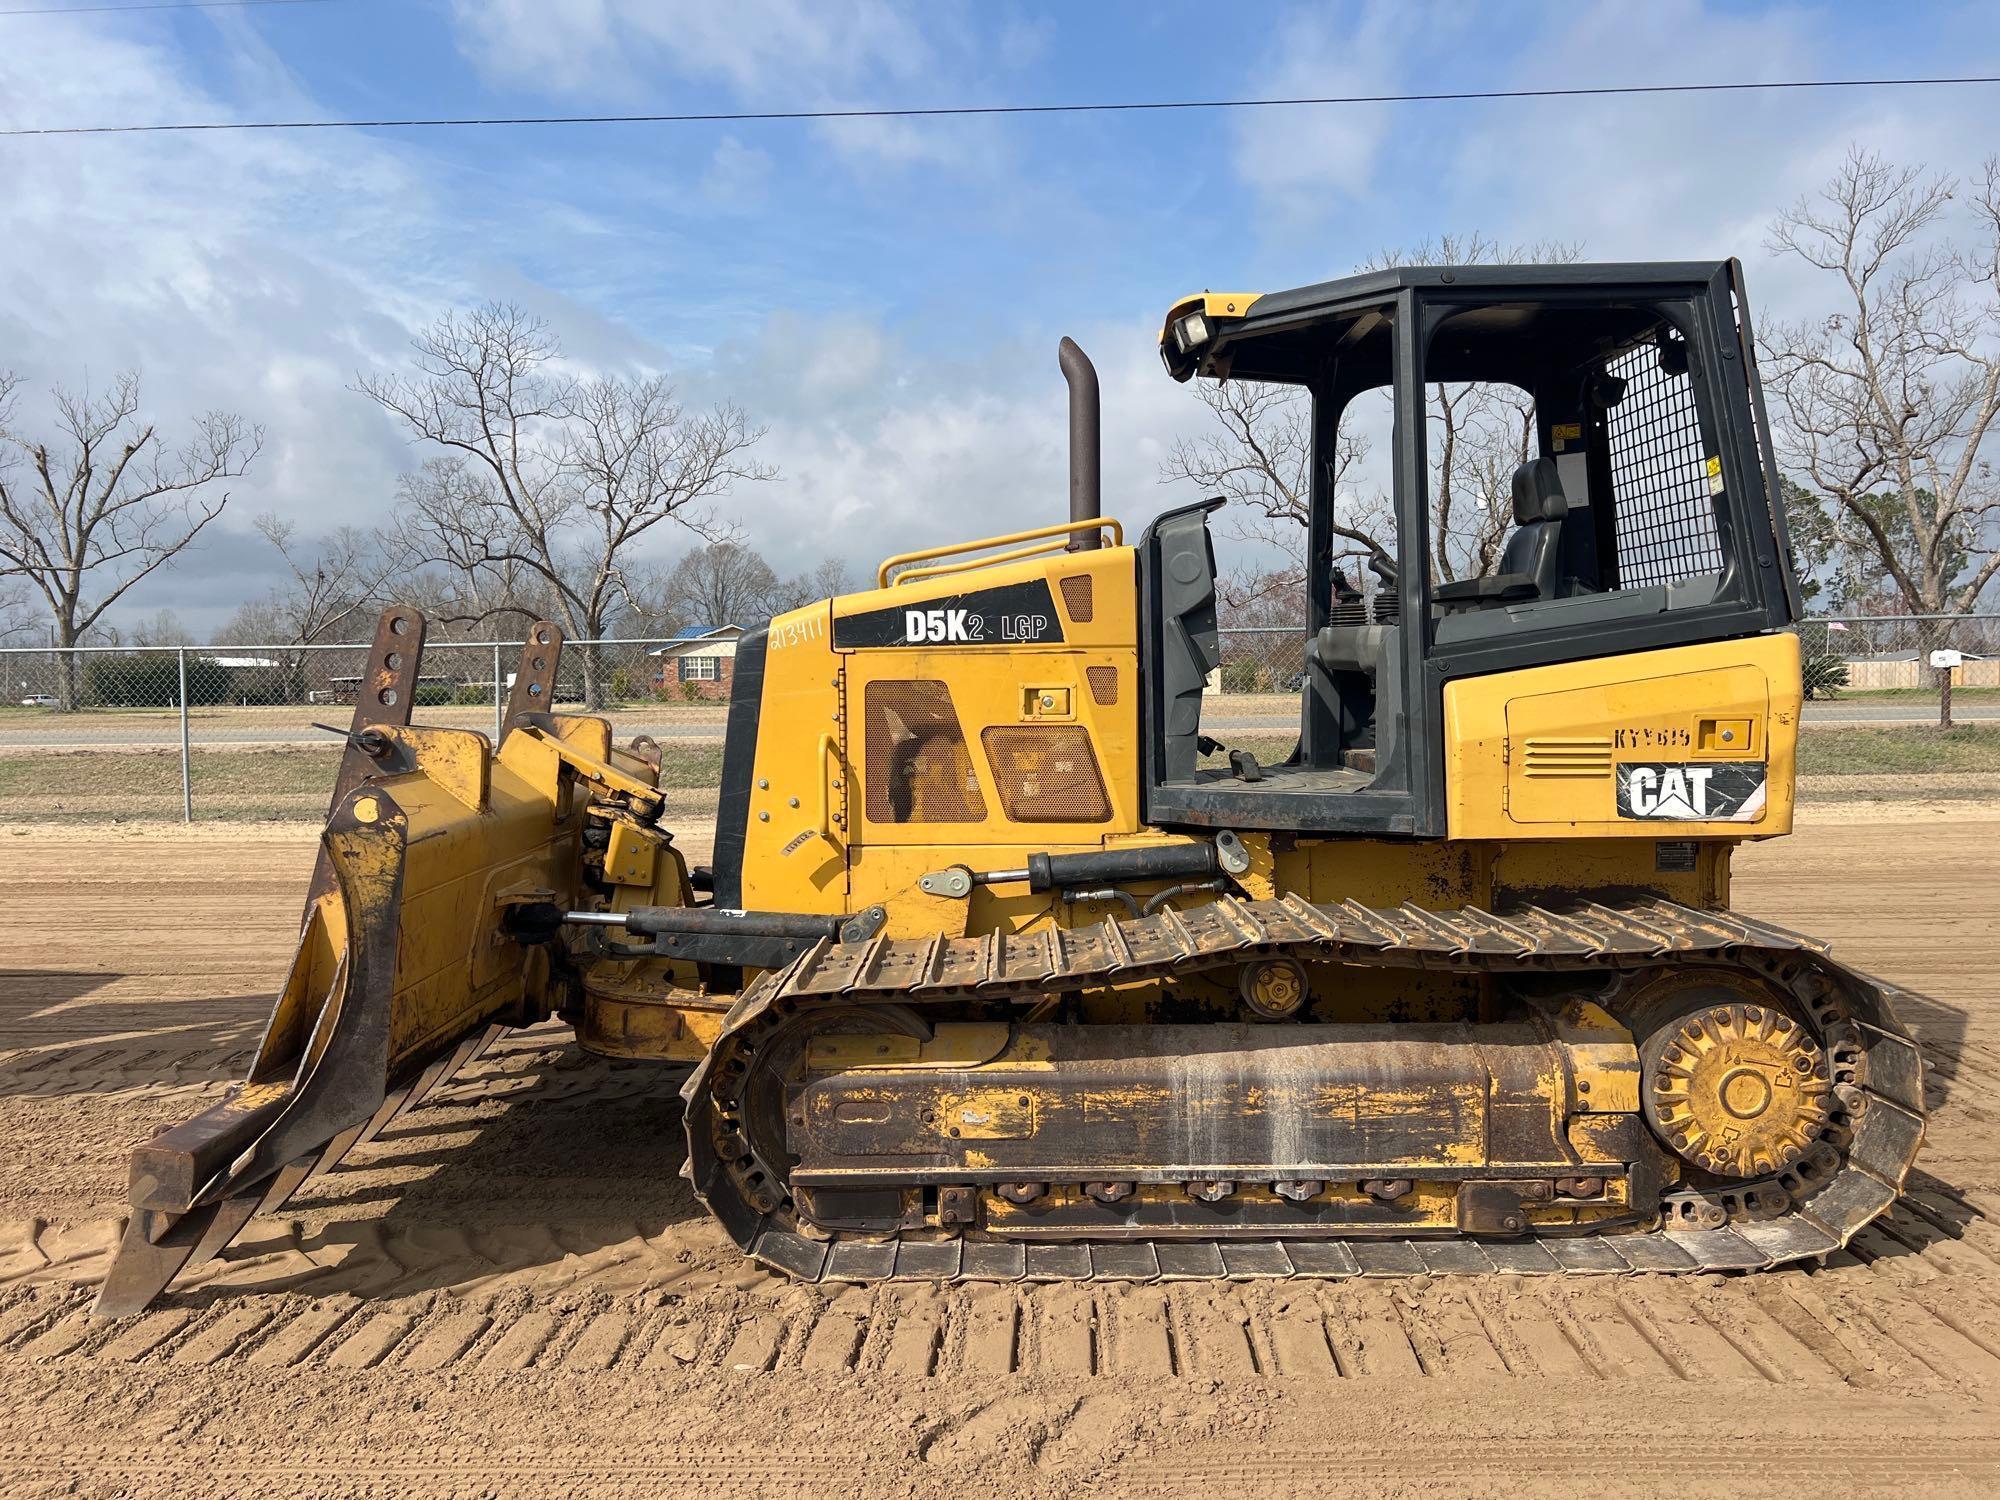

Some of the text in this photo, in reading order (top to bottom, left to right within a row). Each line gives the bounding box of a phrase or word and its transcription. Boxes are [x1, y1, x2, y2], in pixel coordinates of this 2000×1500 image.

[770, 616, 822, 650] 213411
[1001, 614, 1048, 640] LGP
[1630, 767, 1713, 817] CAT
